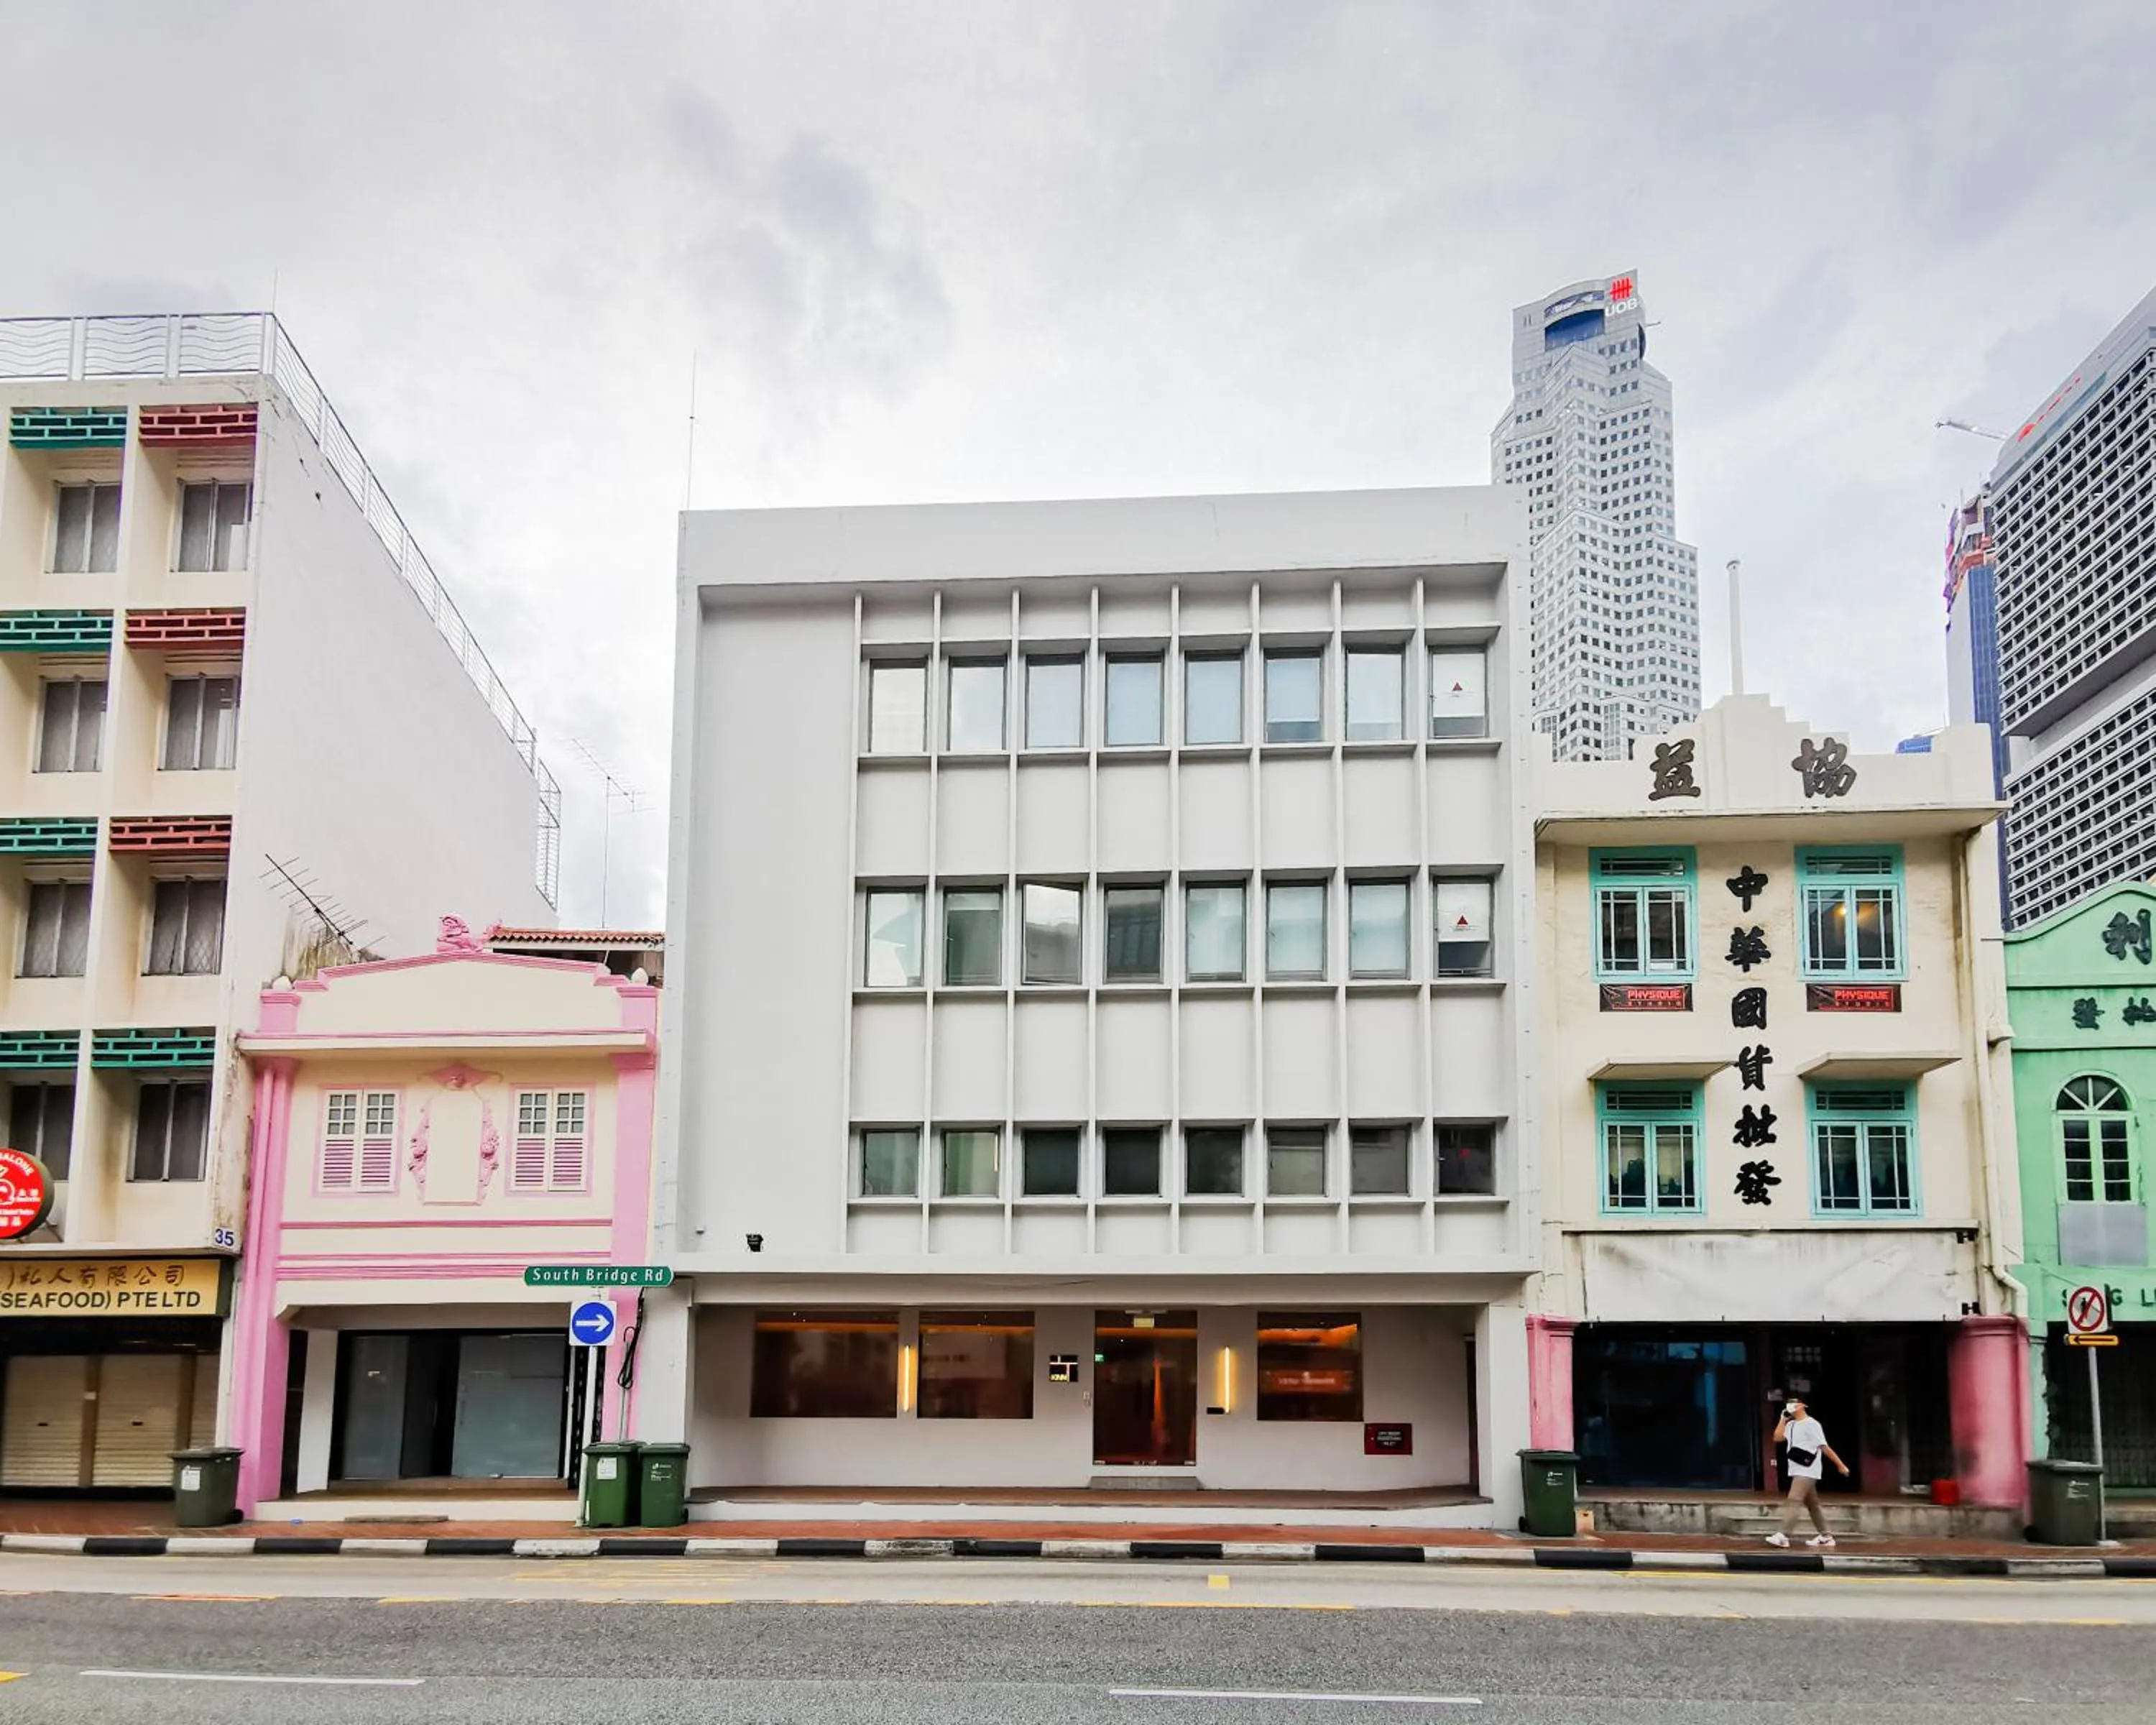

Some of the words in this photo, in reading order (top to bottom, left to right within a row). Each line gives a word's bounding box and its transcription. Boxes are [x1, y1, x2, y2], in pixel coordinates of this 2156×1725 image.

[1605, 298, 1638, 316] UOB
[1628, 990, 1681, 999] PHYSIQUE
[1835, 990, 1889, 999] PHYSIQUE
[215, 1228, 234, 1246] 35
[533, 1268, 579, 1281] South
[586, 1269, 638, 1284] Bridge
[645, 1268, 663, 1282] Rd
[0, 1292, 111, 1309] SEAFOOD)
[117, 1292, 158, 1307] PTE
[162, 1292, 201, 1307] LTD
